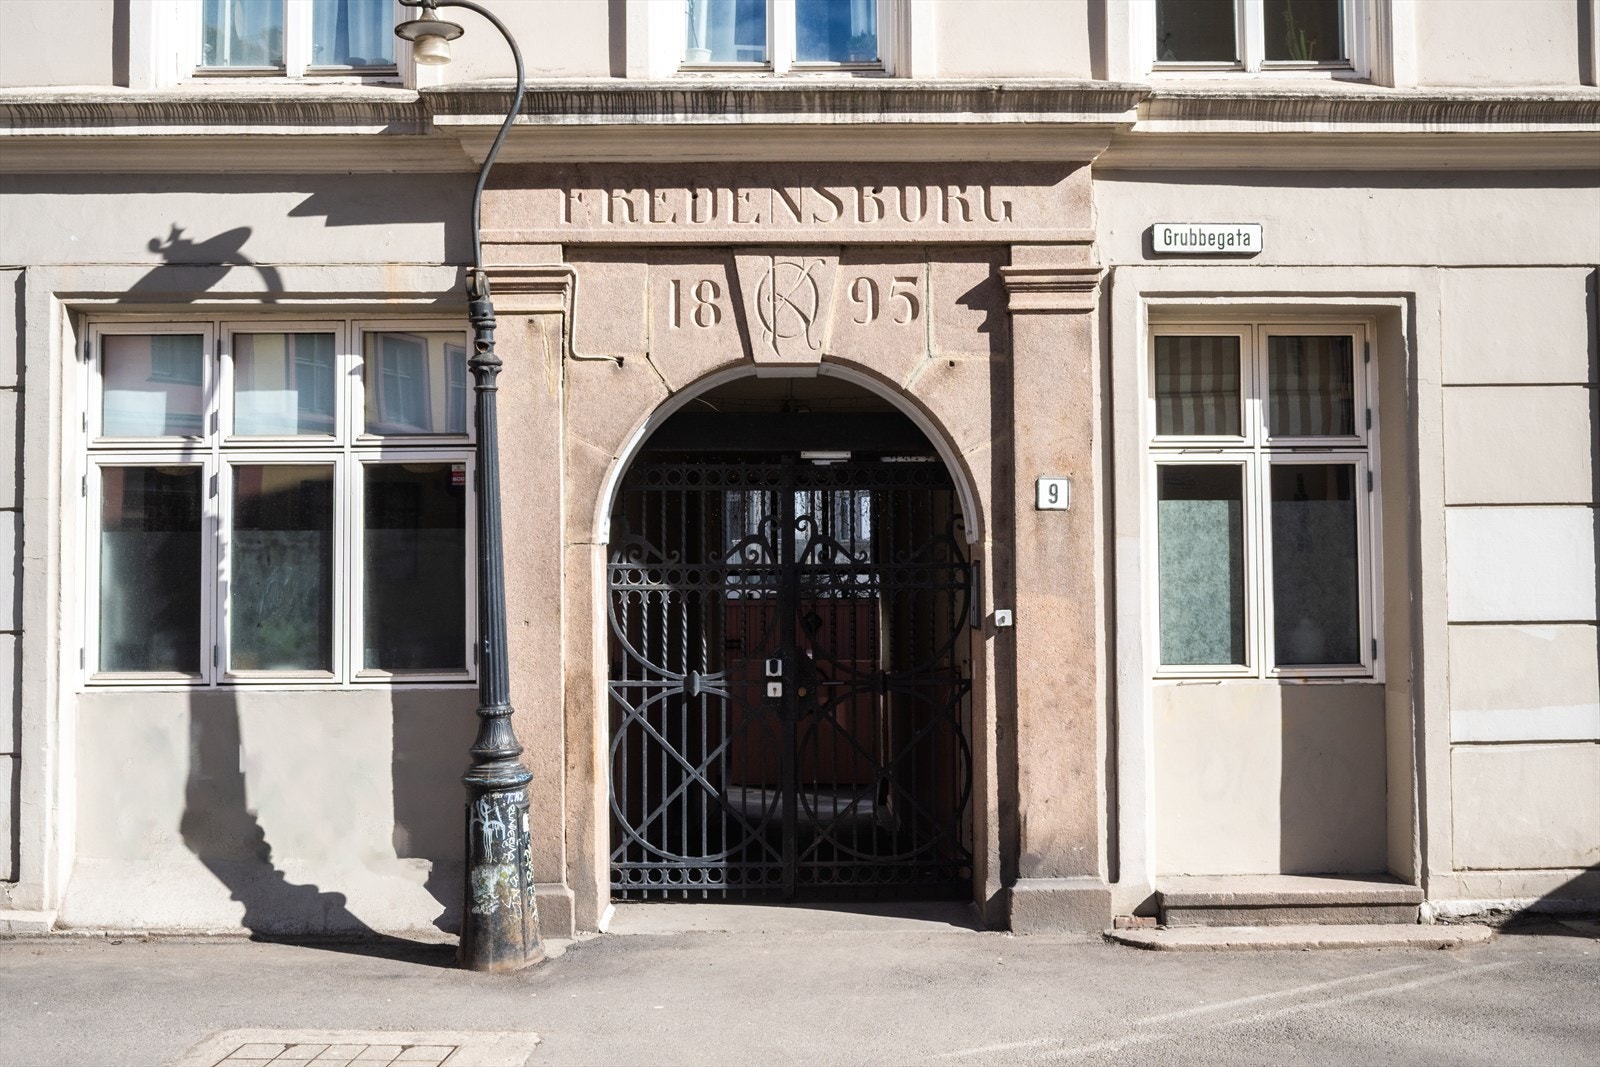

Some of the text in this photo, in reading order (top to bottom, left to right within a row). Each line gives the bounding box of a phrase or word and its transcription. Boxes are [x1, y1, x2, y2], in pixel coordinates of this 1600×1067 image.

[559, 177, 1014, 224] FREDENSBURG
[1163, 227, 1251, 250] Grubbegata
[668, 275, 921, 330] 18 95
[1047, 482, 1059, 505] 9
